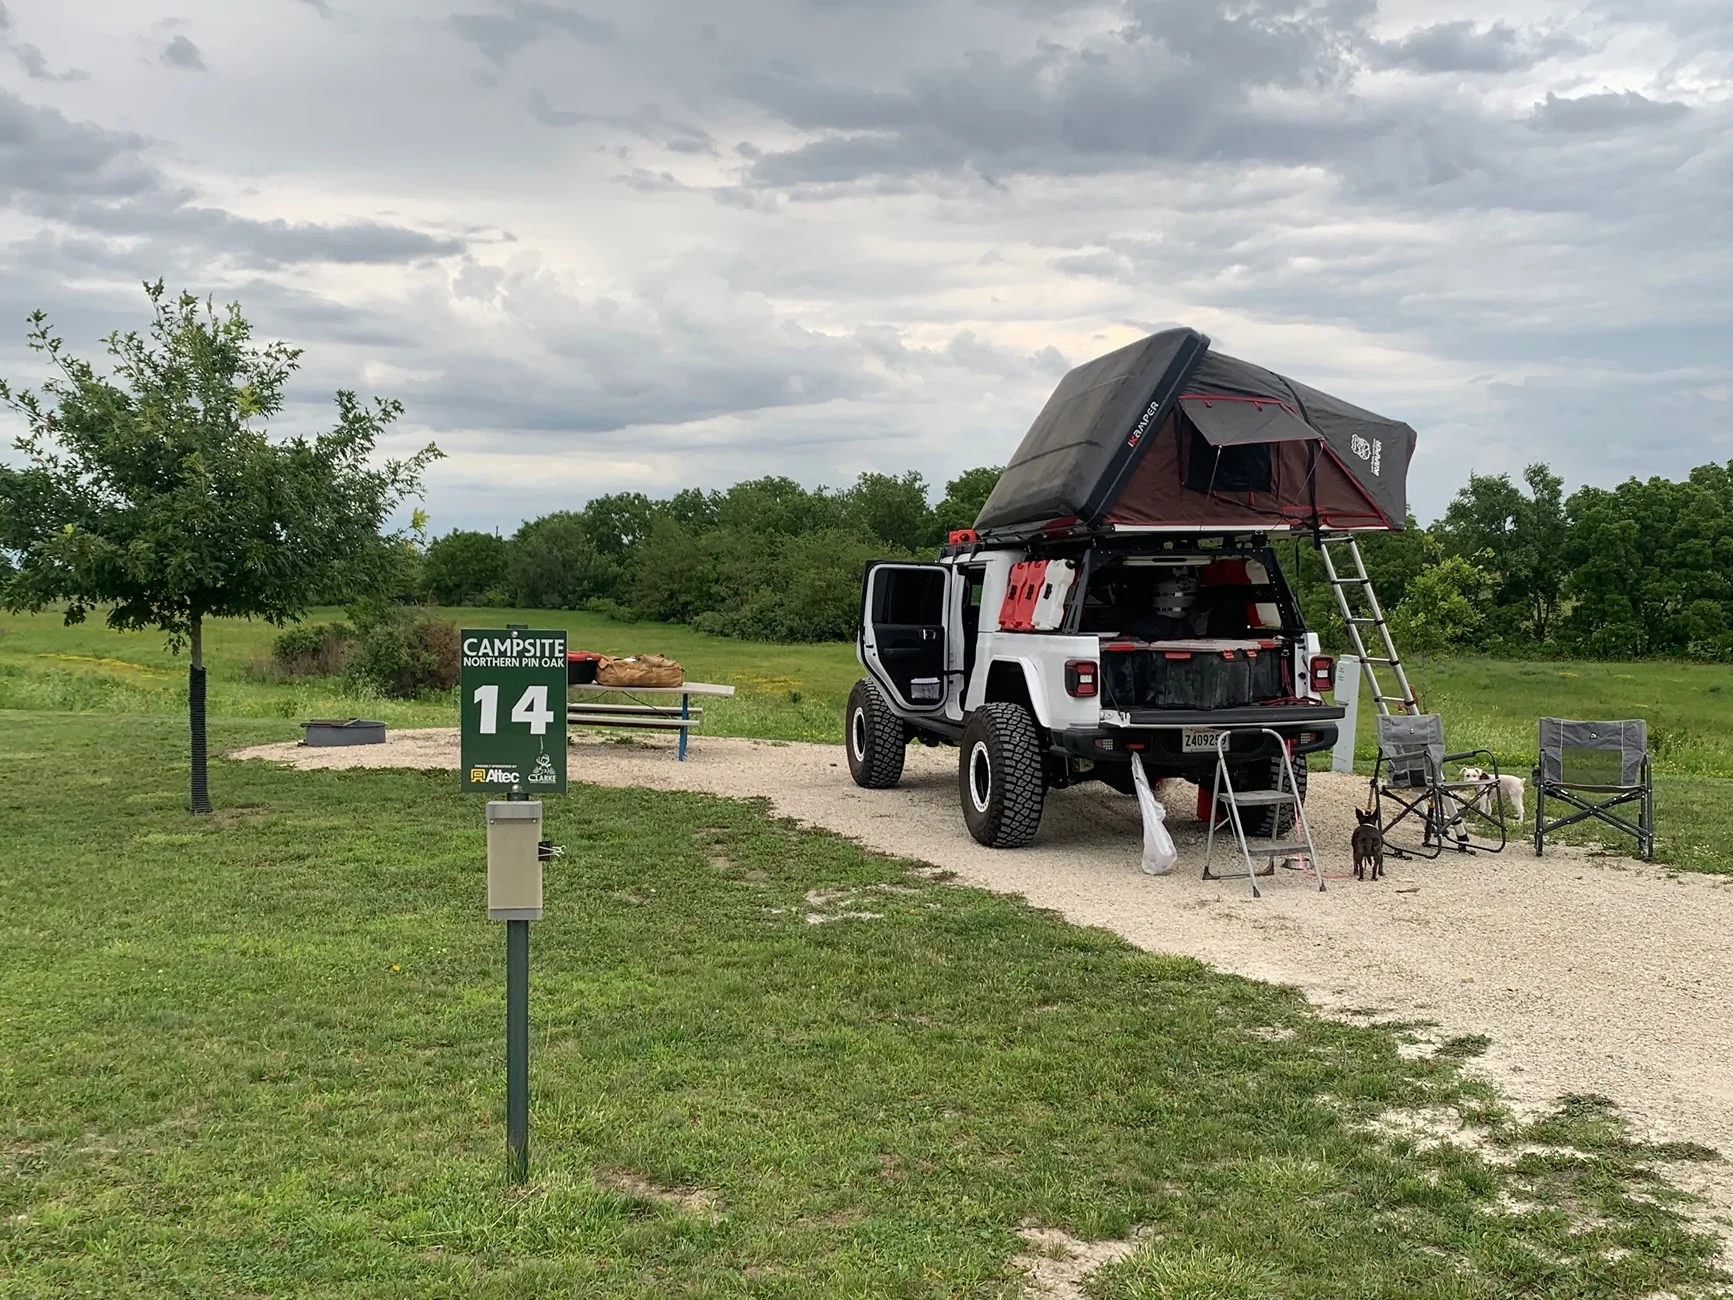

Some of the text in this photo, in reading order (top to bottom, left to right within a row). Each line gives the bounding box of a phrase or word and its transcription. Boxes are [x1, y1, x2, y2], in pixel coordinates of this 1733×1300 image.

[463, 638, 565, 657] CAMPSITE
[463, 657, 565, 668] NORTHERN PIN OAK
[473, 685, 554, 735] 14
[485, 768, 520, 783] Altec
[527, 774, 557, 782] CLARKE
